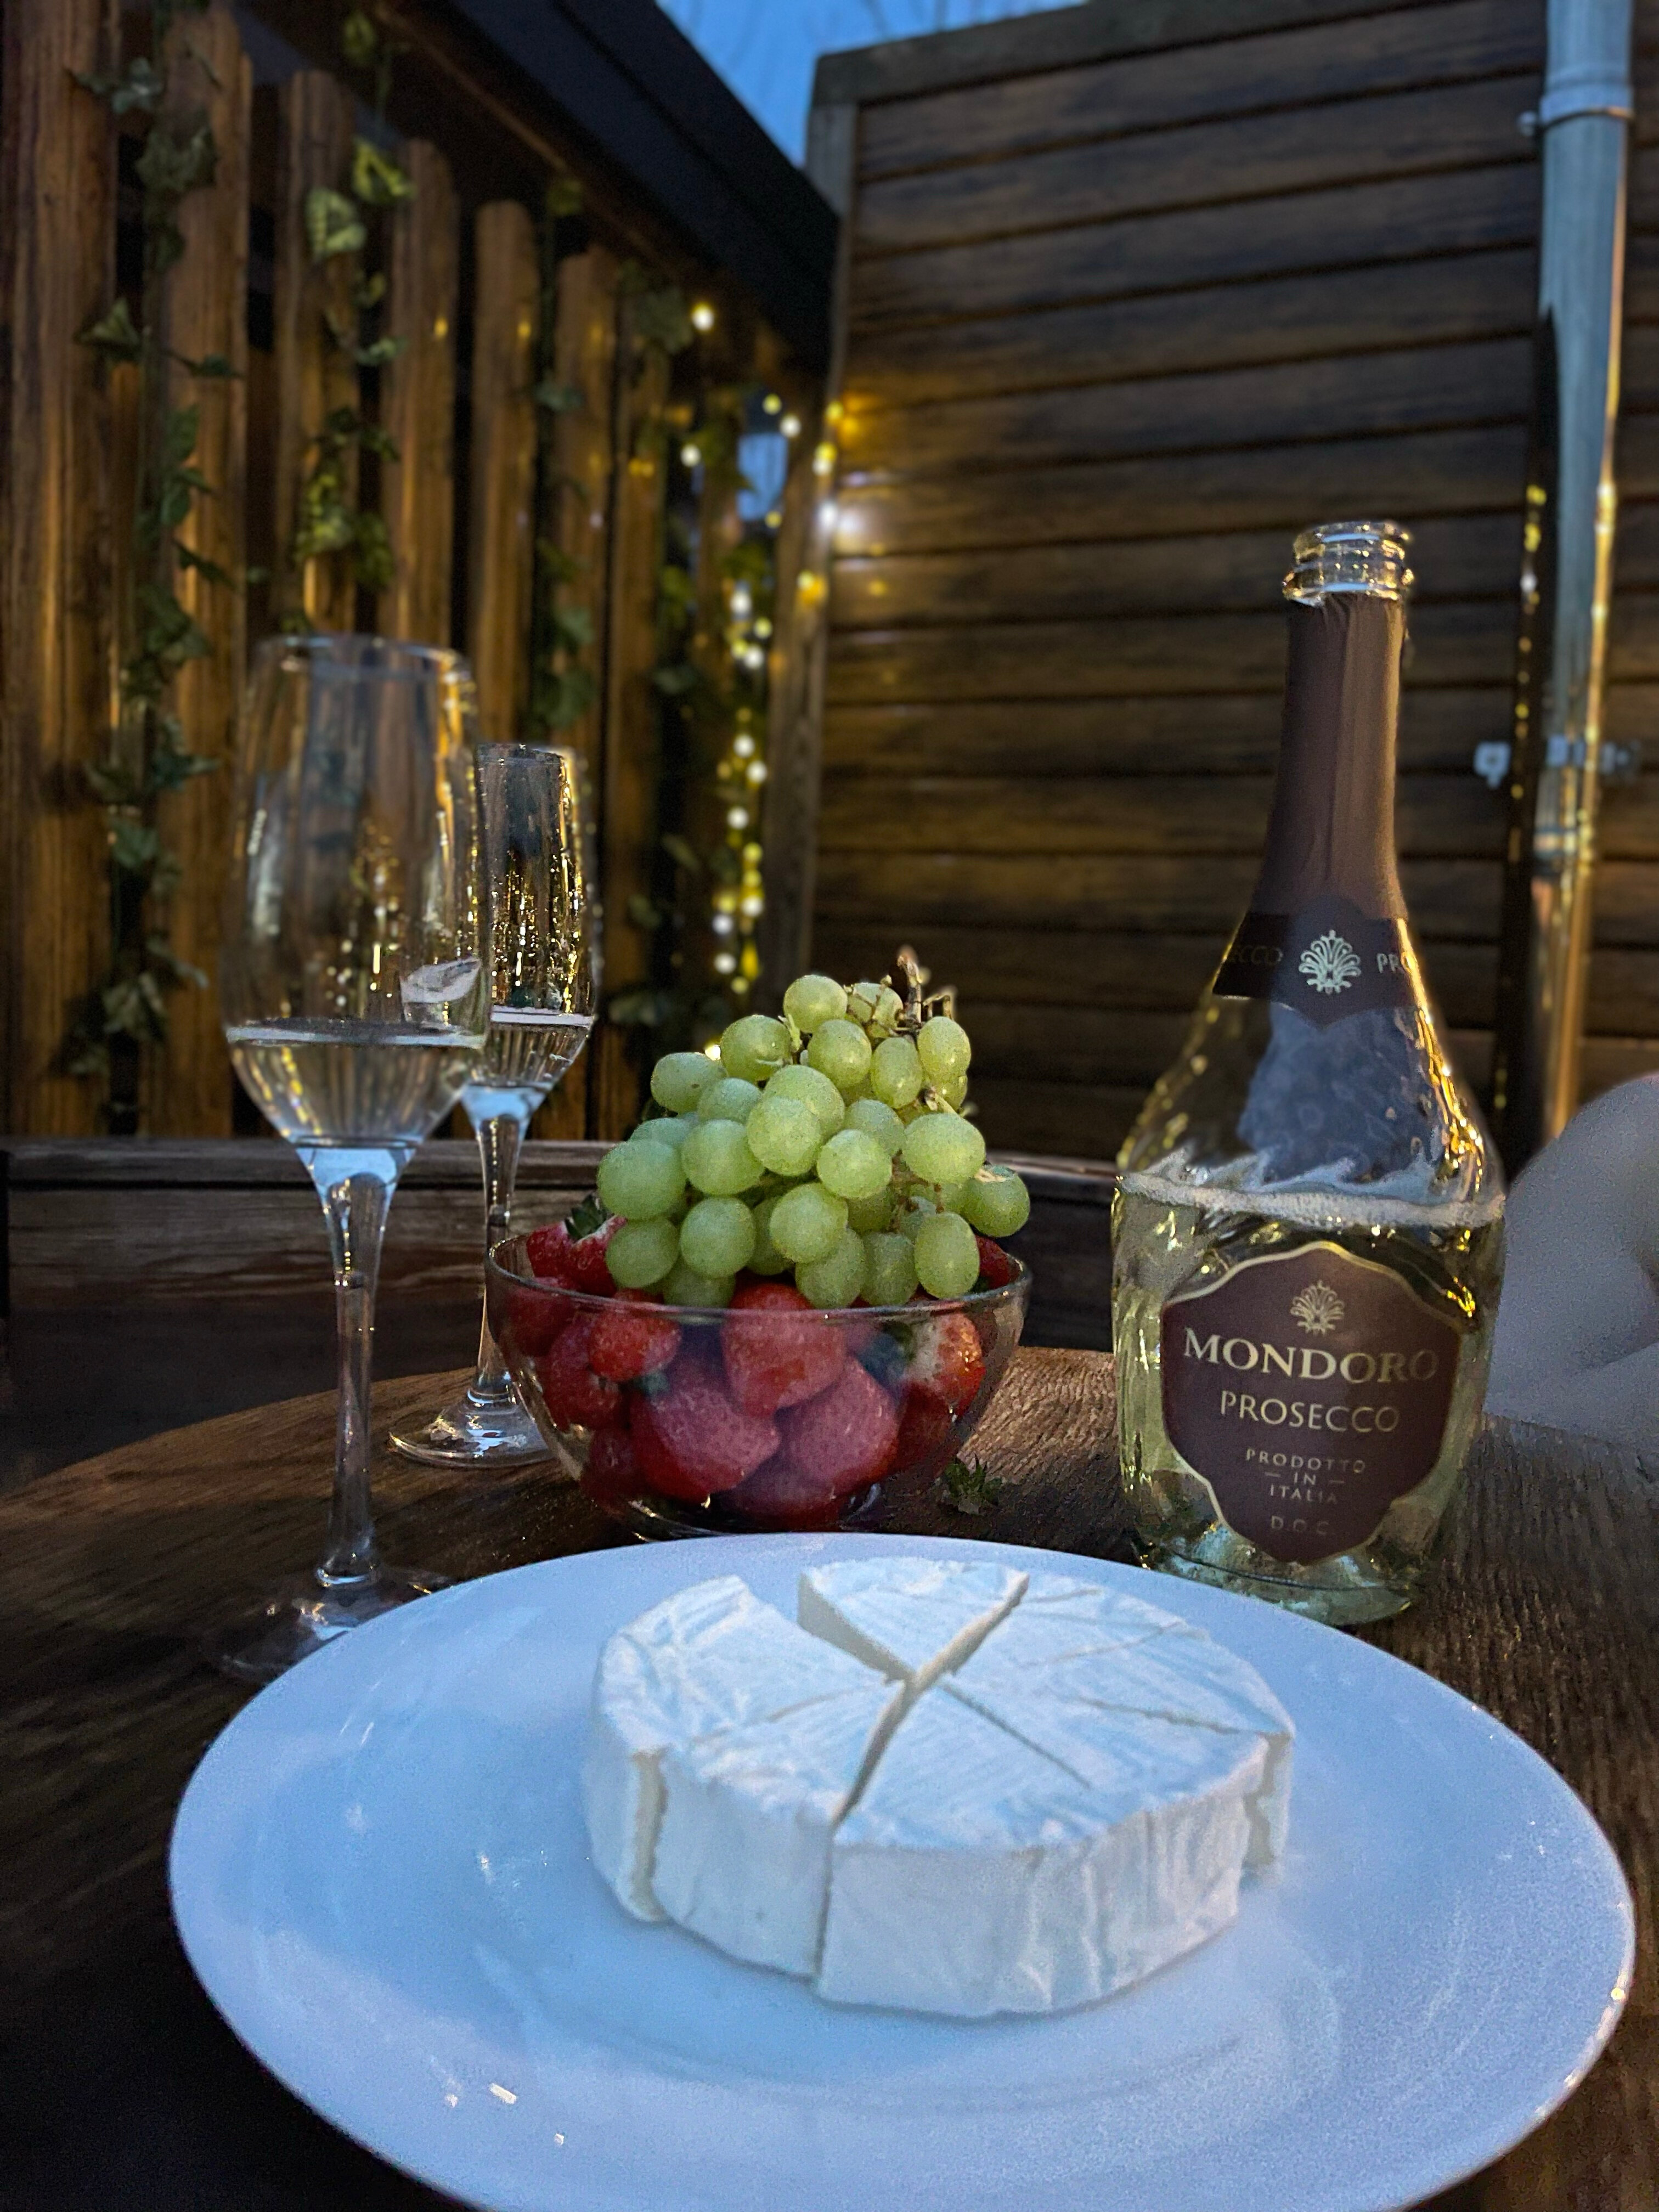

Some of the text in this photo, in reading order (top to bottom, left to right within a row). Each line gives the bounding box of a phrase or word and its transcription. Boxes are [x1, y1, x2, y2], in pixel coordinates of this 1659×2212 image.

[1183, 1327, 1439, 1385] MONDORO
[1220, 1390, 1400, 1433] PROSECCO
[1246, 1447, 1365, 1474] PRODOTTO
[1293, 1471, 1317, 1485] IN
[1270, 1484, 1337, 1505] ITALIA
